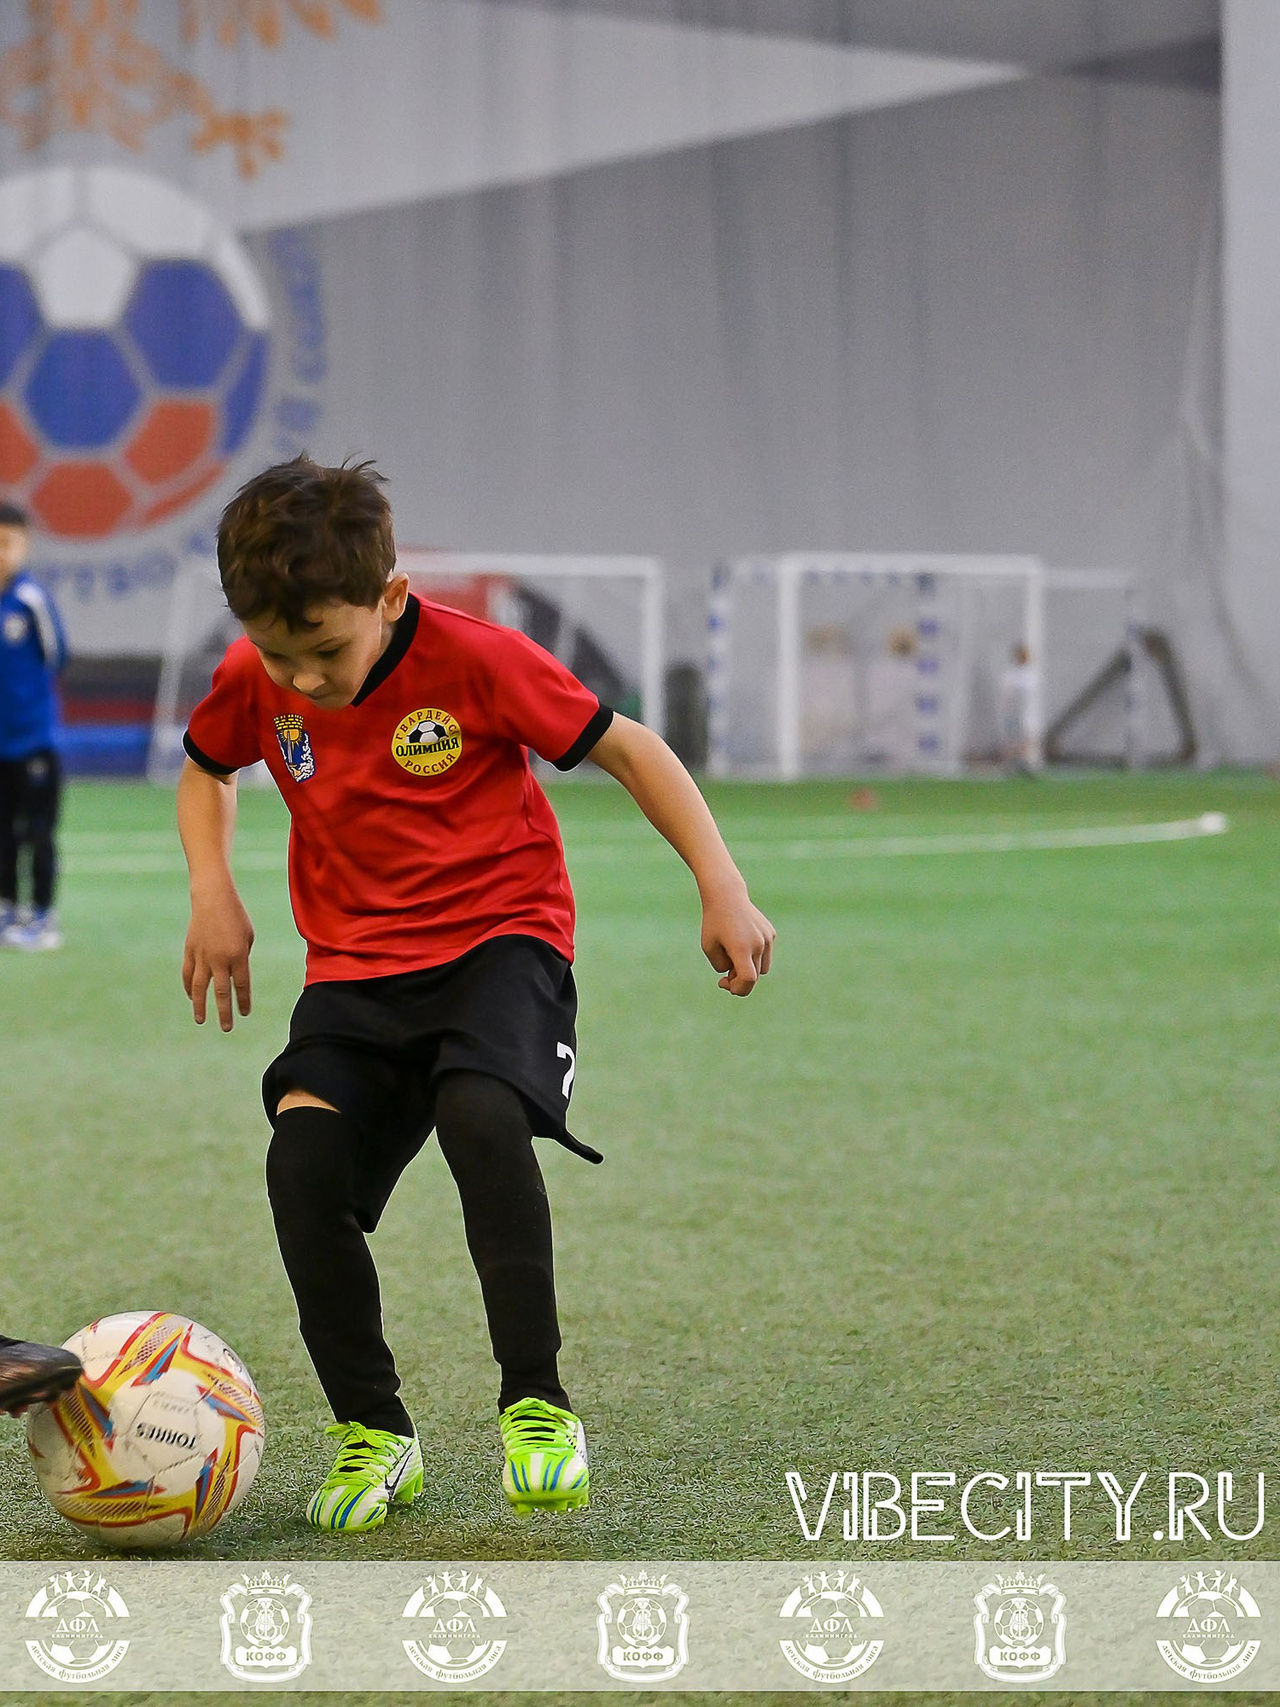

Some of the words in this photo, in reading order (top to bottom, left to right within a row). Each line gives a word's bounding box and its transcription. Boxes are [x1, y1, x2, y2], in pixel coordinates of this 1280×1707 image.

[395, 737, 460, 757] ОЛИМПИЯ
[403, 753, 456, 774] РОССИЯ
[556, 1041, 576, 1100] 7
[136, 1422, 203, 1450] TORRES
